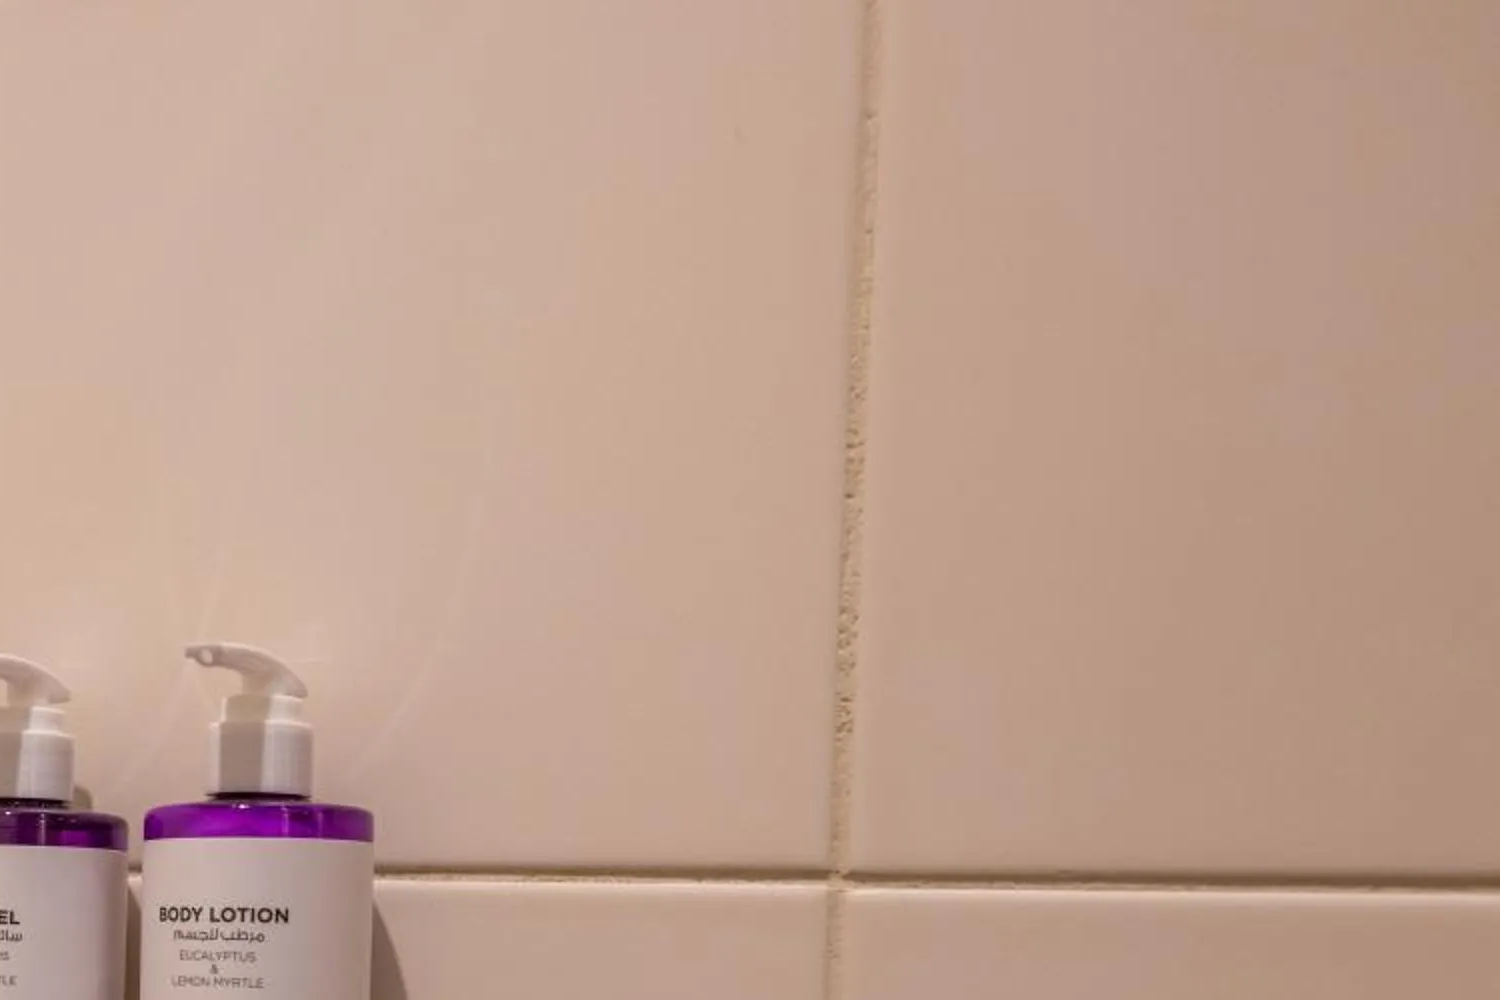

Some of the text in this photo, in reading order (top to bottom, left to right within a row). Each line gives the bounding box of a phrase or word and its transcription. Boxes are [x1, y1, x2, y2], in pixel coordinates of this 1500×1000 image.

[159, 906, 289, 923] BODY LOTION
[179, 949, 257, 963] EUCALYPTUS
